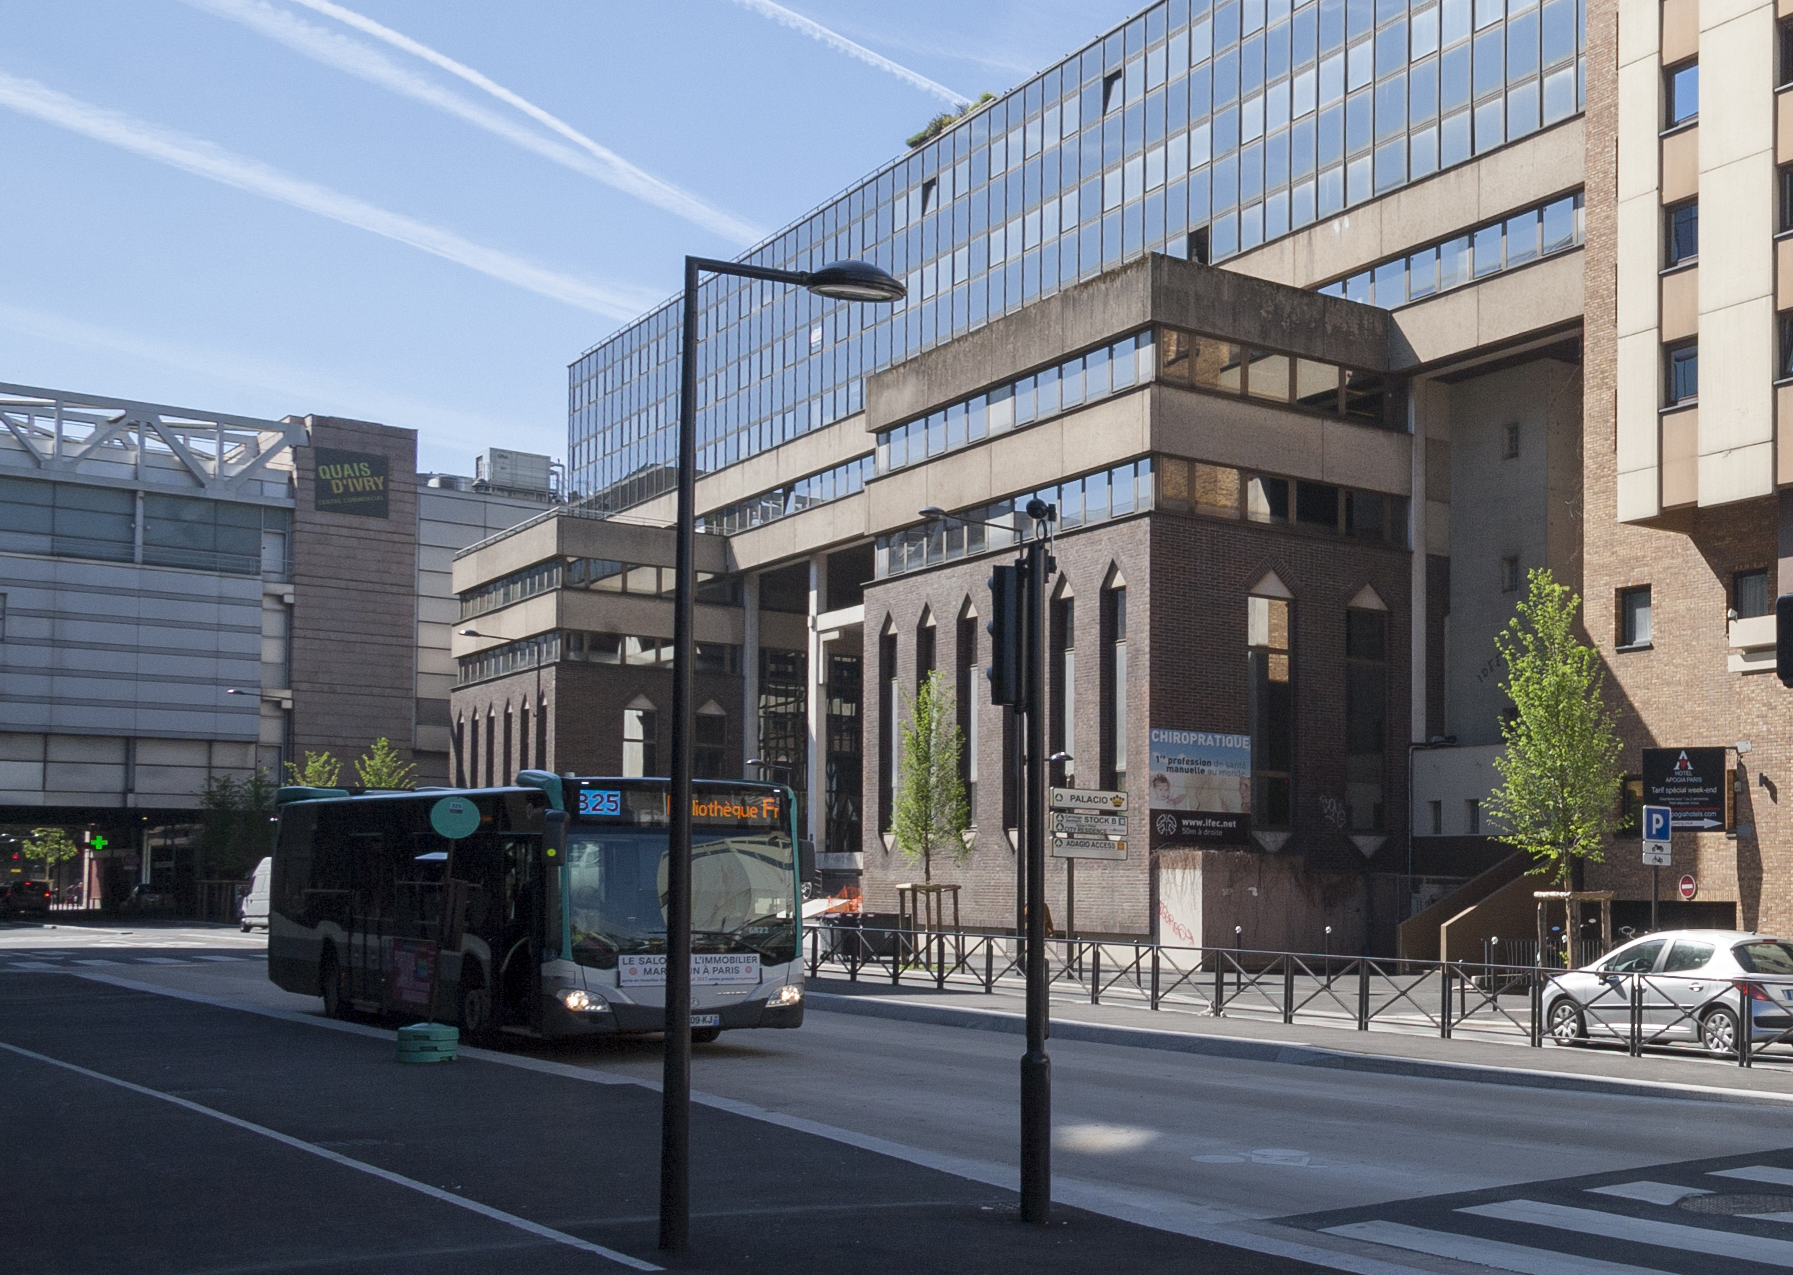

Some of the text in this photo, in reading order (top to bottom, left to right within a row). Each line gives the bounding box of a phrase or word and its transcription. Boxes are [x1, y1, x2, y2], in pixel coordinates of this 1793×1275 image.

[318, 463, 371, 480] QUAIS
[331, 476, 384, 494] D'IVRY
[1151, 730, 1250, 749] CHIROPRATIQUE
[1168, 756, 1212, 767] profession
[1166, 766, 1206, 774] manuelle
[1070, 795, 1108, 804] PALACIO
[1182, 819, 1237, 828] www.ifec.net
[1652, 814, 1664, 834] P
[1066, 840, 1116, 849] ADAGIO ACCESS
[622, 955, 758, 965] LE SALO L'IMMOBILIER
[703, 964, 709, 974] À
[712, 966, 740, 974] PARIS
